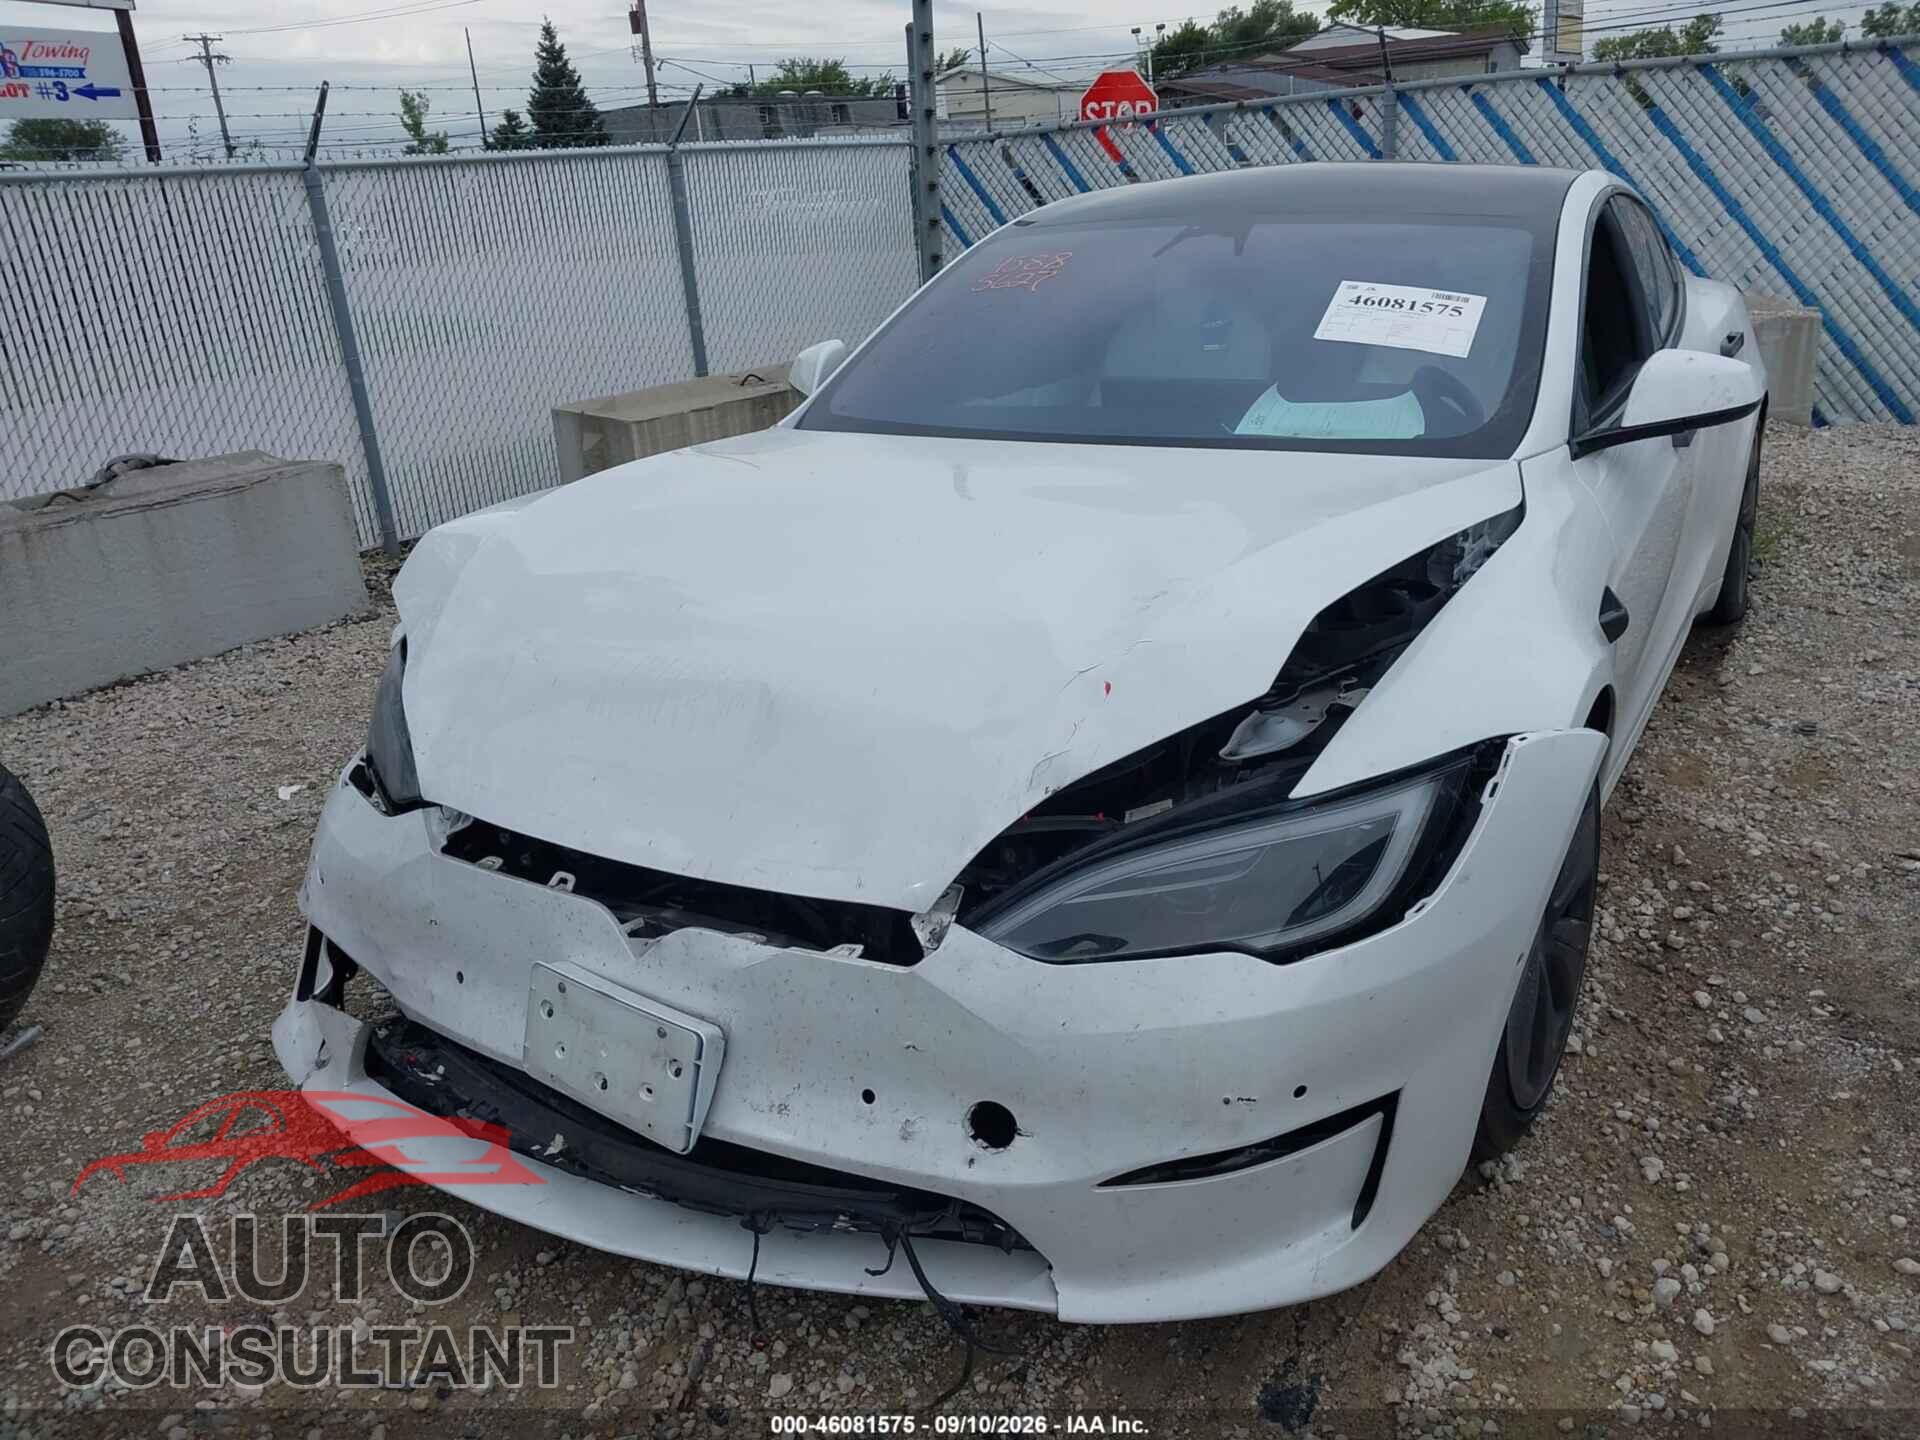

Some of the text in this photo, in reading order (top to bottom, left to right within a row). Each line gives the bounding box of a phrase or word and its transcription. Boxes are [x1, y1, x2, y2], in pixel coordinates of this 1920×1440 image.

[22, 40, 90, 65] Towing
[35, 81, 70, 101] #3
[1348, 294, 1464, 317] 46081575
